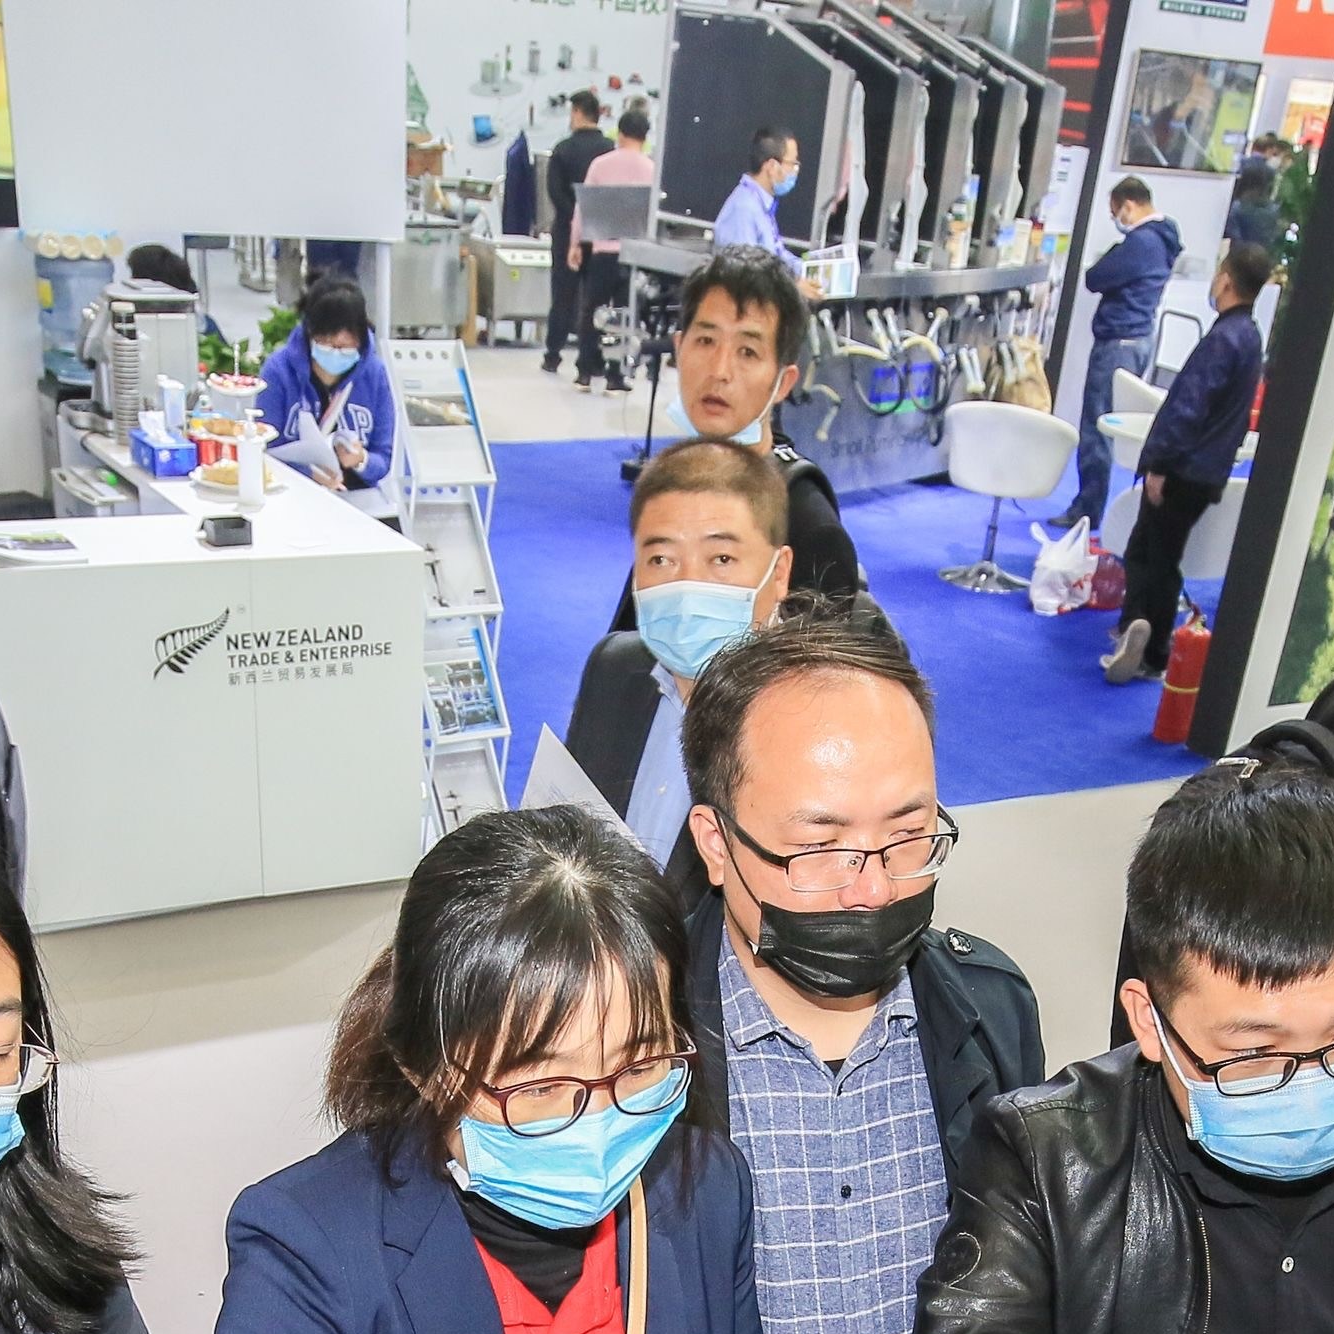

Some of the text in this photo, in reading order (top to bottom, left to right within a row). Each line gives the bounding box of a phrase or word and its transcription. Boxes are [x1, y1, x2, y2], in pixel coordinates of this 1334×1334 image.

[226, 623, 363, 651] NEW ZEALAND
[227, 641, 392, 669] TRADE & ENTERPRISE
[228, 661, 354, 686] 新西兰贸易发展局
